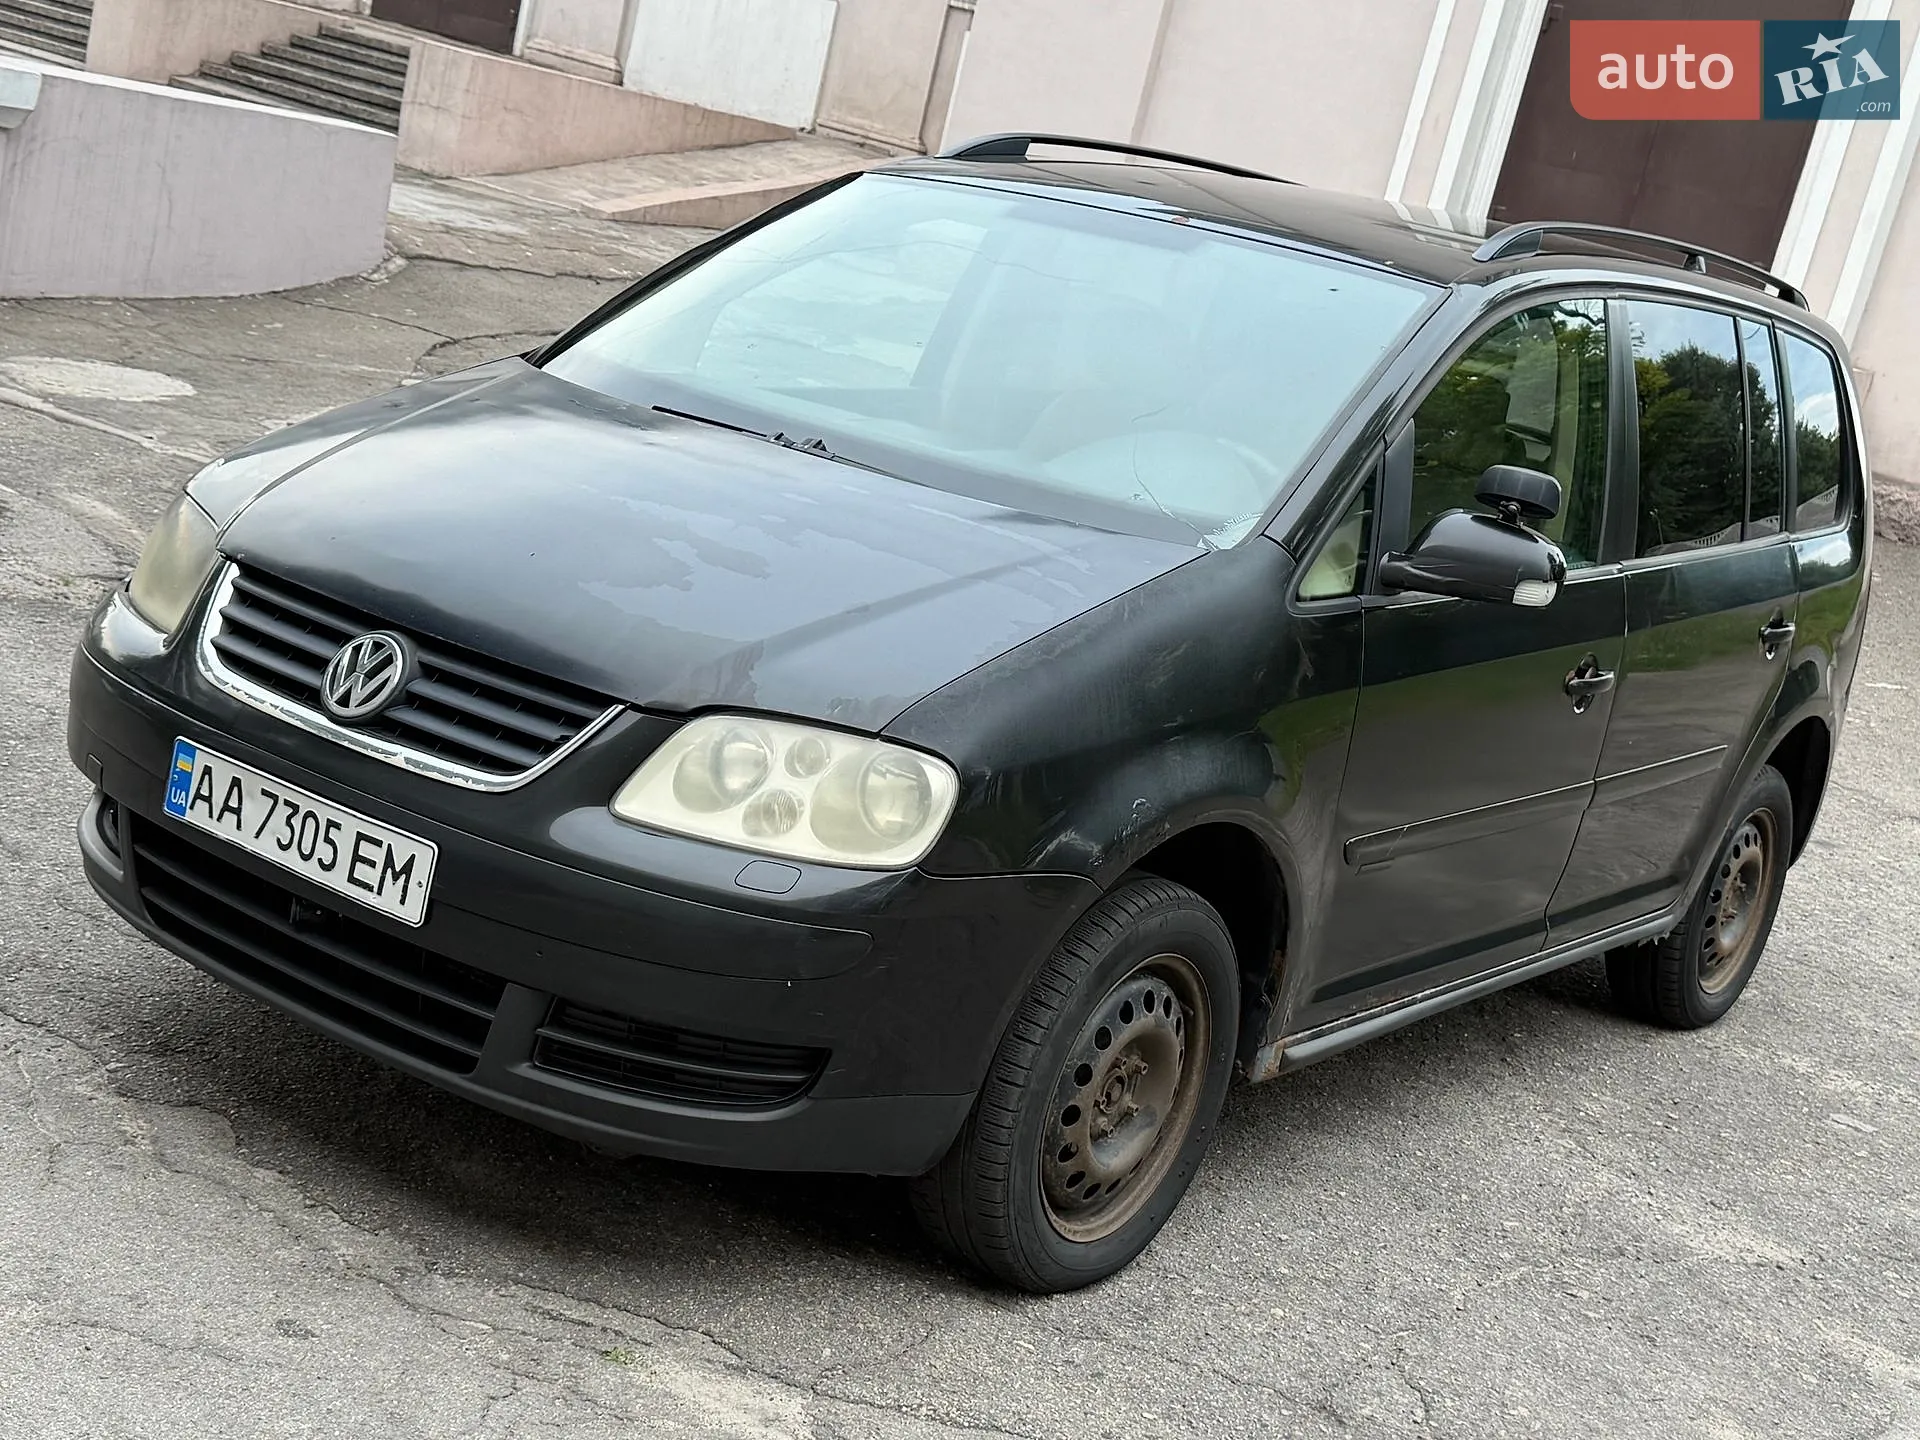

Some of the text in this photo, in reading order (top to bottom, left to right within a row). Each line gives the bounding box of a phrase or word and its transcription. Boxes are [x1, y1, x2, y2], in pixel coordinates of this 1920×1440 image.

[171, 788, 187, 807] UA
[189, 764, 416, 906] AA 7305 EM
